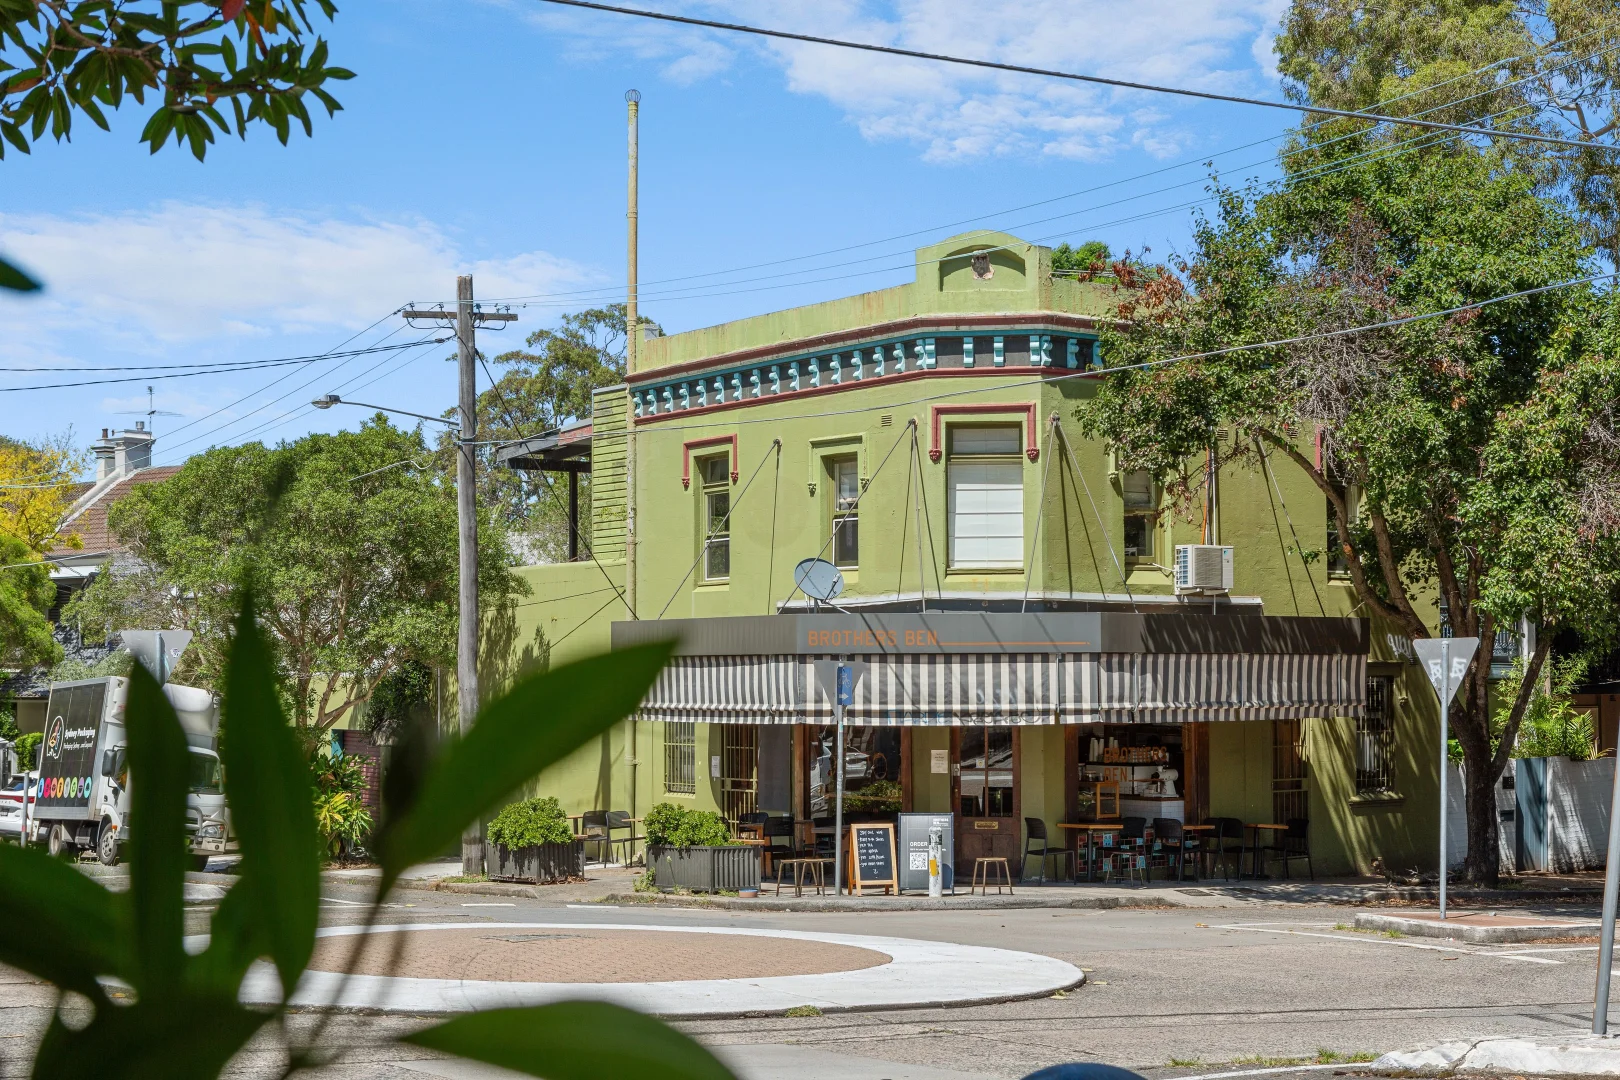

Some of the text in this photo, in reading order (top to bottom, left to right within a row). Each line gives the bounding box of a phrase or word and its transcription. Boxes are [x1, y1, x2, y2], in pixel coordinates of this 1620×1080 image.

[808, 630, 937, 646] BROTHERS BEN
[1104, 746, 1167, 763] BROTHERS
[1104, 767, 1128, 782] BEN
